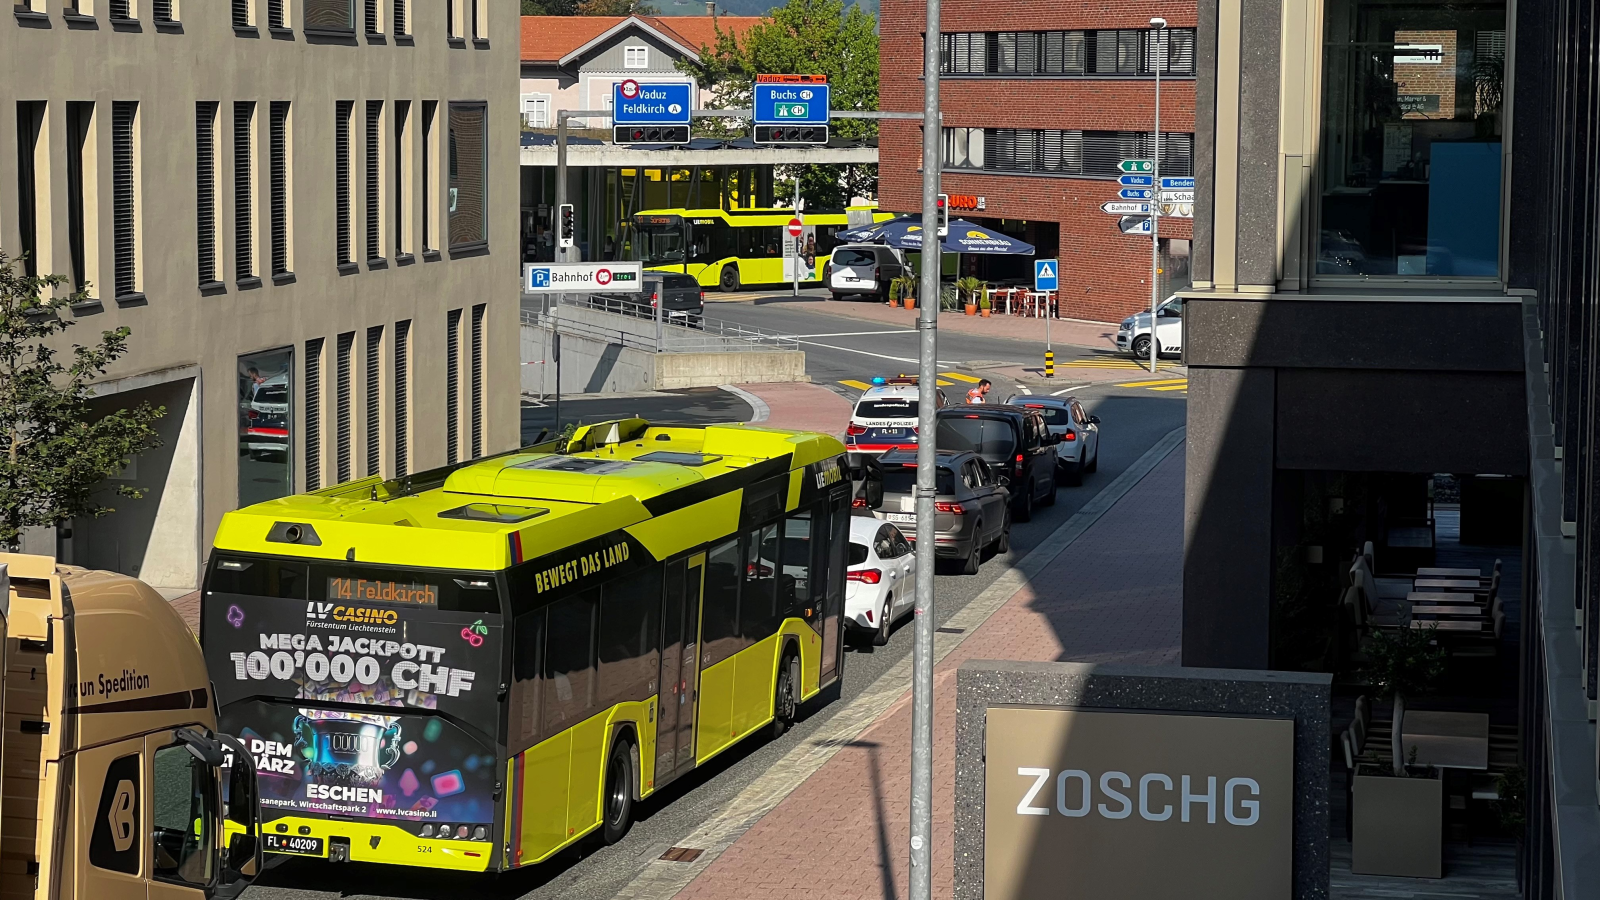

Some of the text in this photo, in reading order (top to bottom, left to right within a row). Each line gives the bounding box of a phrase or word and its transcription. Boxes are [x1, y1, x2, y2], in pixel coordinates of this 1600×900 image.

[757, 74, 781, 83] Vaduz
[638, 90, 667, 100] Vaduz
[770, 90, 811, 100] Buchs CH
[623, 104, 678, 114] Feldkirch A
[792, 106, 803, 115] CH
[552, 271, 593, 282] Bahnhof
[535, 541, 630, 594] BEWEGT DAS LAND
[332, 577, 435, 604] 14 Feldkirch
[306, 601, 398, 625] LV CASINO
[306, 620, 396, 634] Fürstentum Liechtenstein
[259, 633, 446, 663] MEGA JACKPOTT
[98, 669, 150, 699] Spedition
[391, 660, 476, 697] CHF
[251, 739, 293, 758] DEM
[306, 784, 383, 804] ESCHEN
[1016, 767, 1260, 826] ZOSCHG
[260, 797, 298, 808] sanepark,
[299, 801, 361, 813] Wirtschaftspark
[376, 806, 437, 818] www.lvcasino.li
[267, 836, 317, 851] FL 40209
[417, 845, 432, 854] 524
